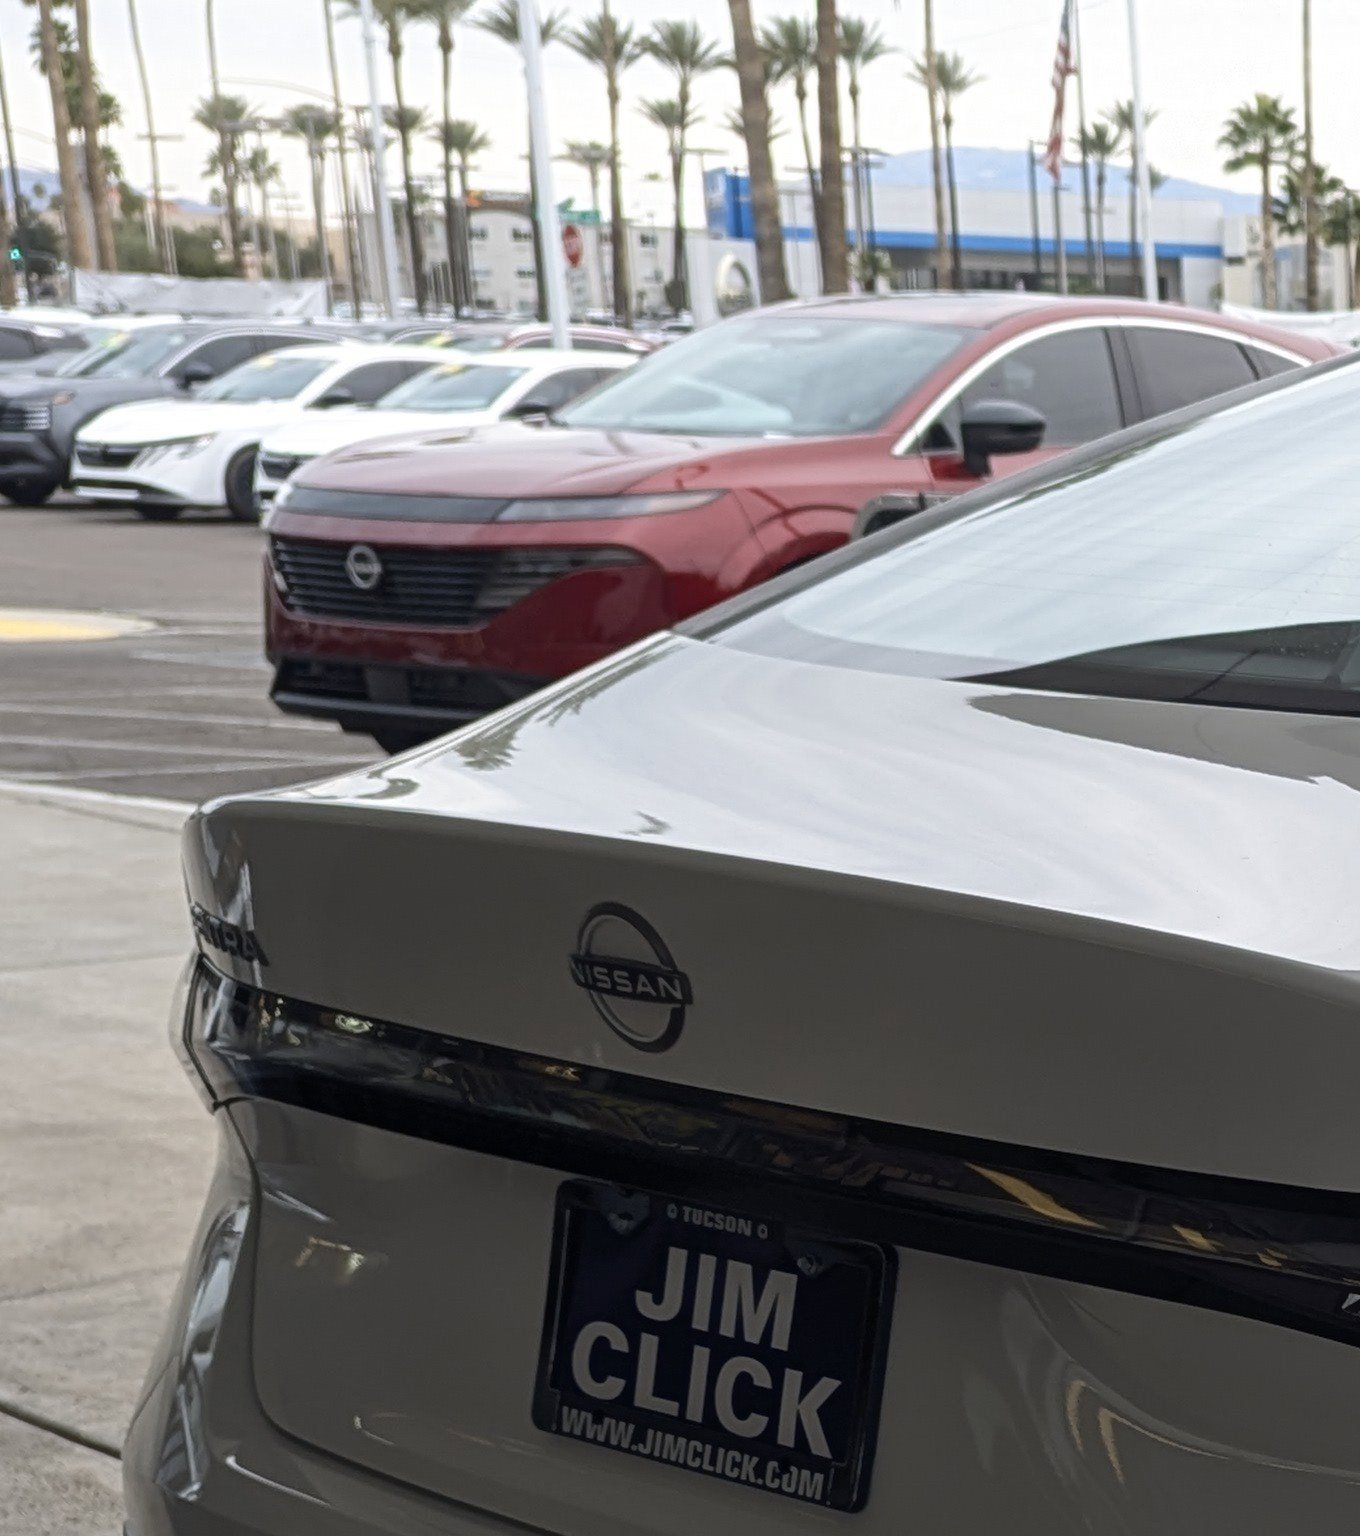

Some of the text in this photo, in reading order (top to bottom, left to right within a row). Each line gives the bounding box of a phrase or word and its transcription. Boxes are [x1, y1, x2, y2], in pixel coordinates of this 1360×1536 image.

[569, 960, 683, 1000] NISSAN
[682, 1205, 752, 1237] TUCSON
[635, 1246, 799, 1352] JIM
[571, 1320, 843, 1460] CLICK
[561, 1405, 825, 1500] WWW.JIMCLICK.COM
